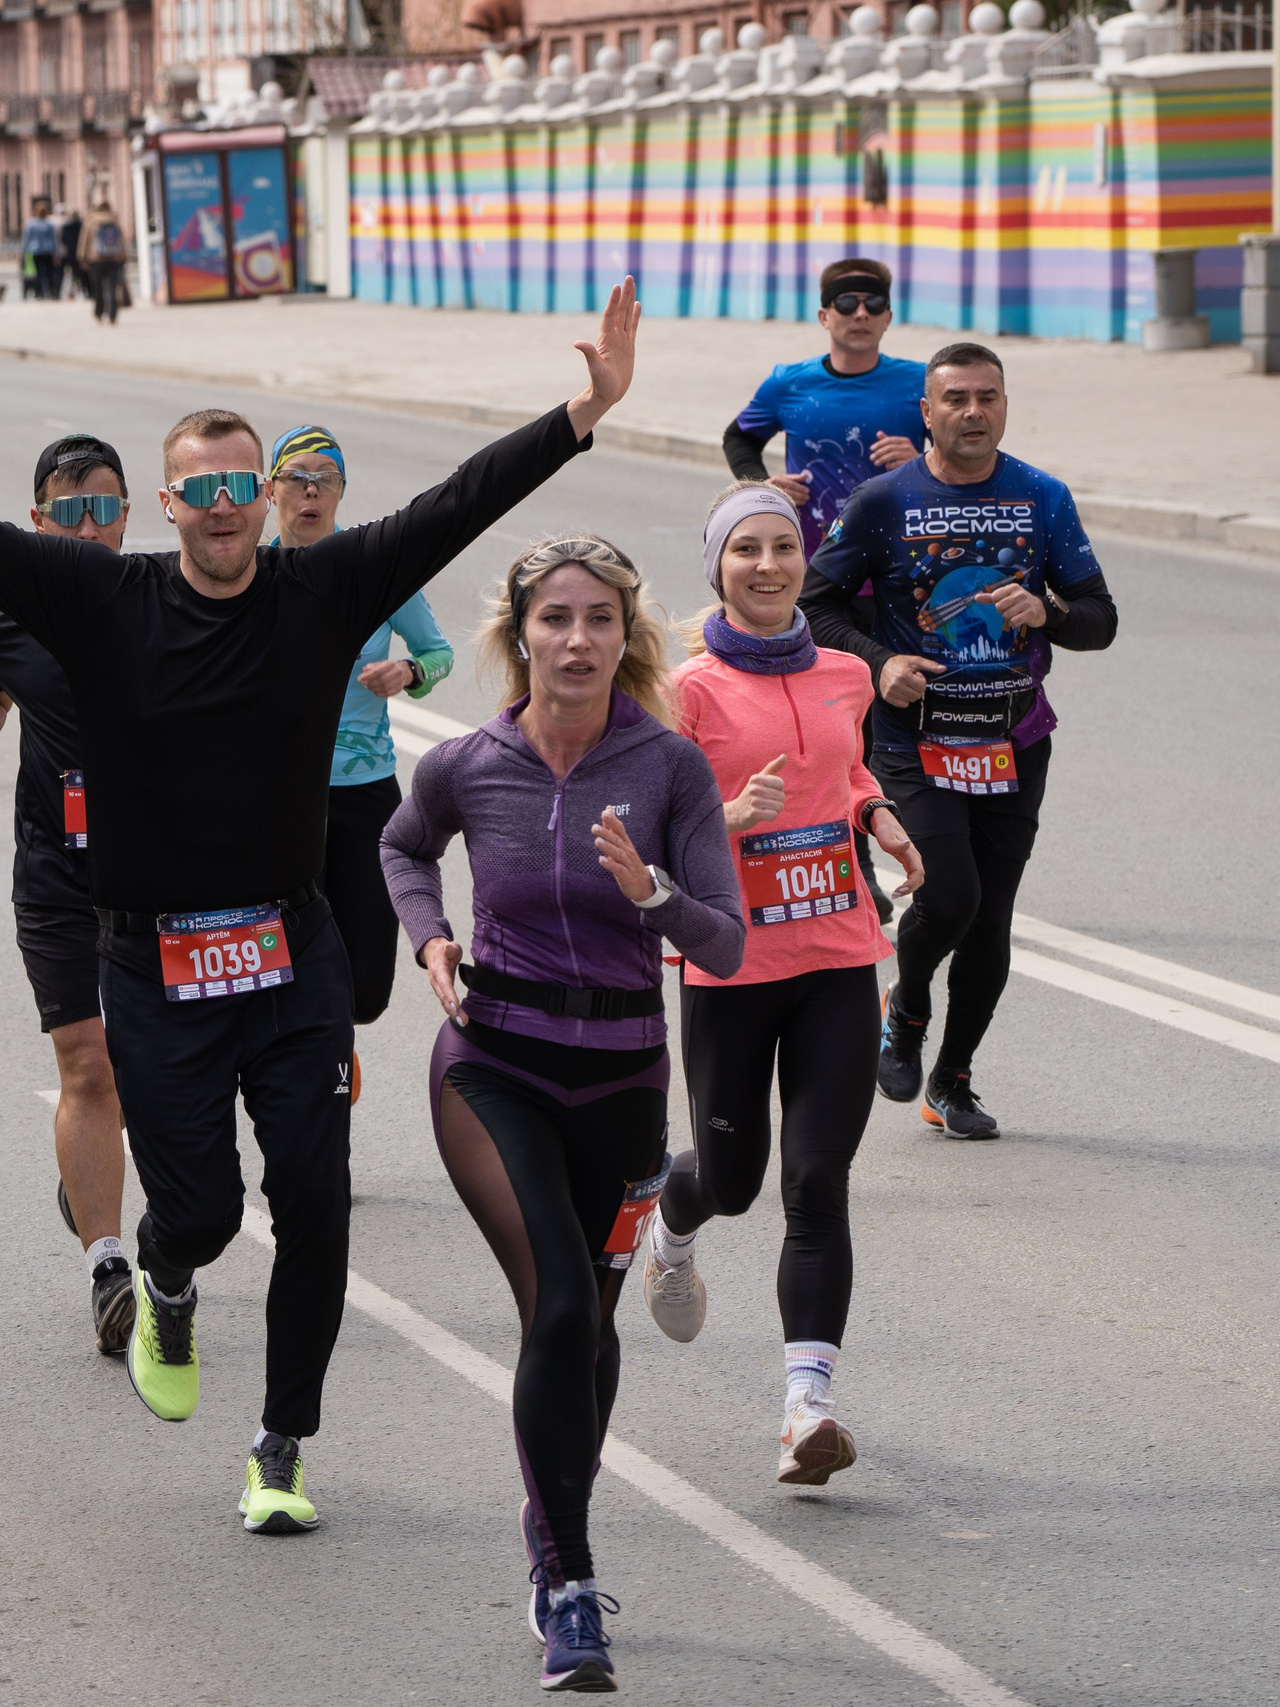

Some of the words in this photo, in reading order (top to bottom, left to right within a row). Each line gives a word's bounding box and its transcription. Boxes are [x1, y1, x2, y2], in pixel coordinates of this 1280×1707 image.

[905, 509, 922, 521] Я
[927, 505, 1031, 519] ПРОСТО
[905, 519, 1033, 537] КОСМОС
[932, 711, 1004, 723] POWERUP
[942, 755, 991, 780] 1491
[998, 758, 1005, 766] B
[785, 829, 823, 840] ПРОСТО
[778, 836, 824, 848] КОСМОС
[780, 849, 823, 862] АНАСТАСИЯ
[840, 864, 848, 874] C
[775, 860, 835, 900] 1041
[203, 911, 243, 922] ПРОСТО
[195, 917, 243, 930] КОСМОС
[206, 930, 230, 941] АРТЁМ
[263, 936, 274, 947] C
[189, 940, 262, 979] 1039
